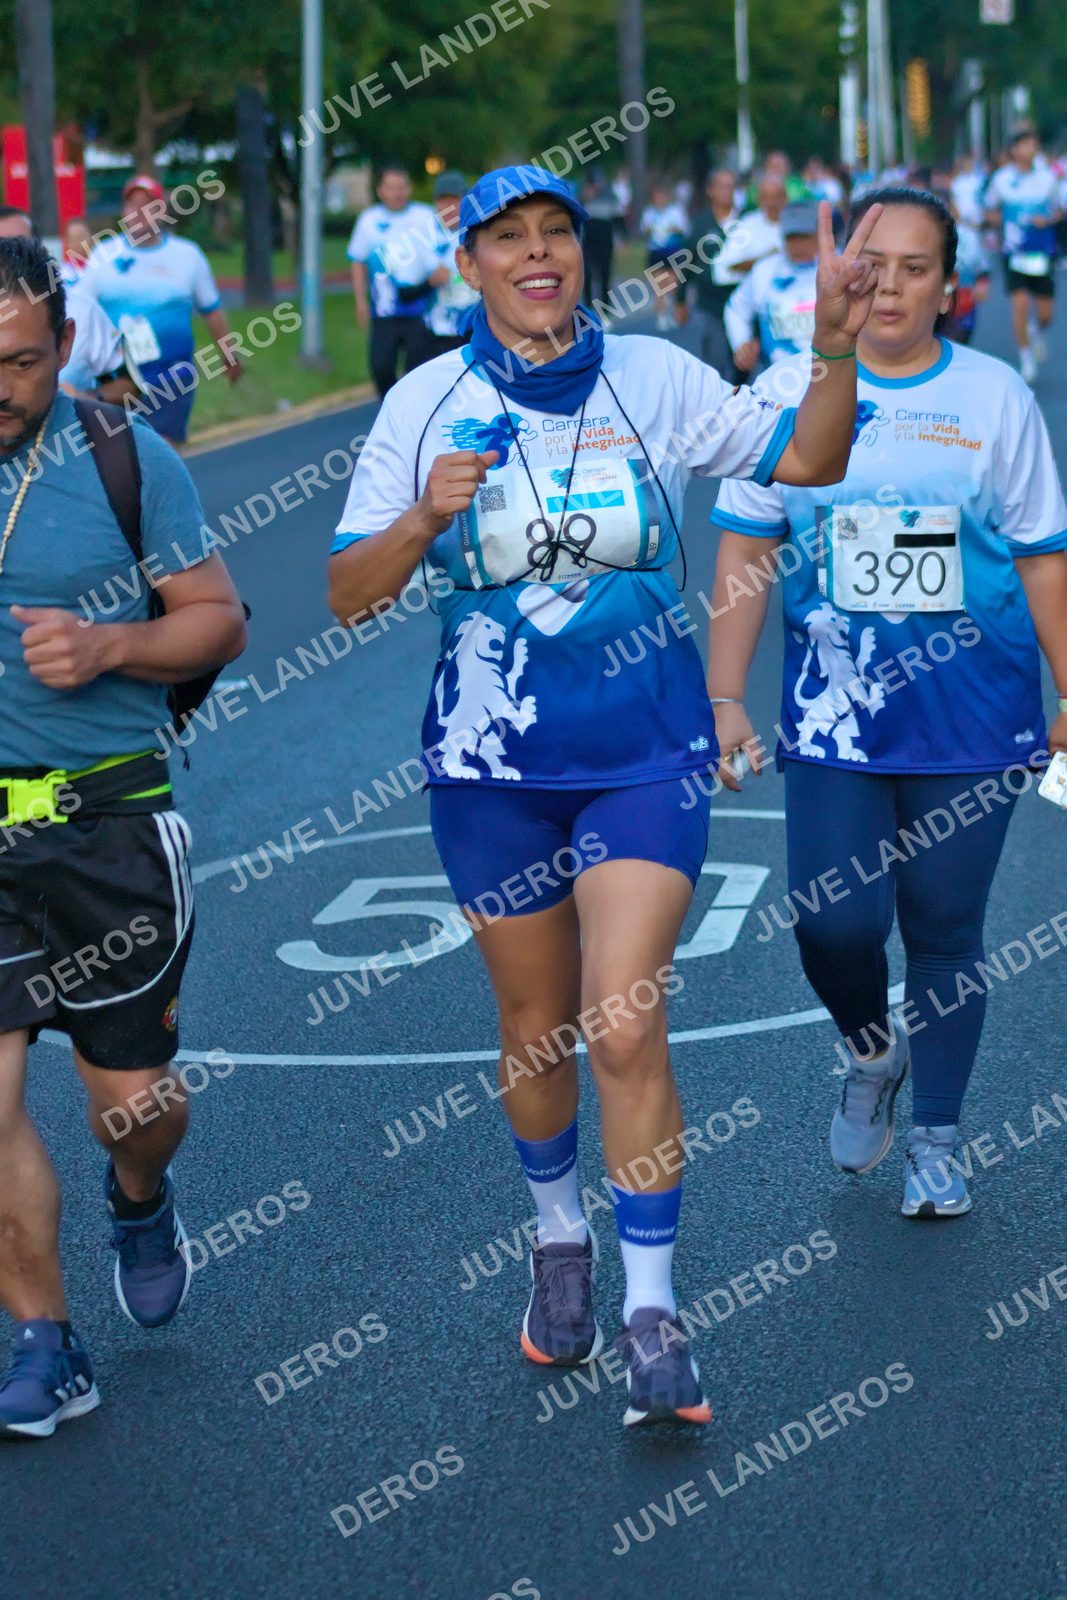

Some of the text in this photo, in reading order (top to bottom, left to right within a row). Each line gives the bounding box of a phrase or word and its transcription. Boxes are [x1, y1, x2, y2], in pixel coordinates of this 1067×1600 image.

[542, 416, 610, 432] Carrera
[895, 409, 959, 424] Carrera
[544, 433, 566, 447] por
[583, 426, 614, 439] Vida
[895, 422, 960, 435] por la Vida
[918, 432, 982, 451] Integridad
[546, 448, 553, 459] y
[557, 444, 568, 455] la
[526, 513, 597, 571] 89
[852, 551, 946, 597] 390
